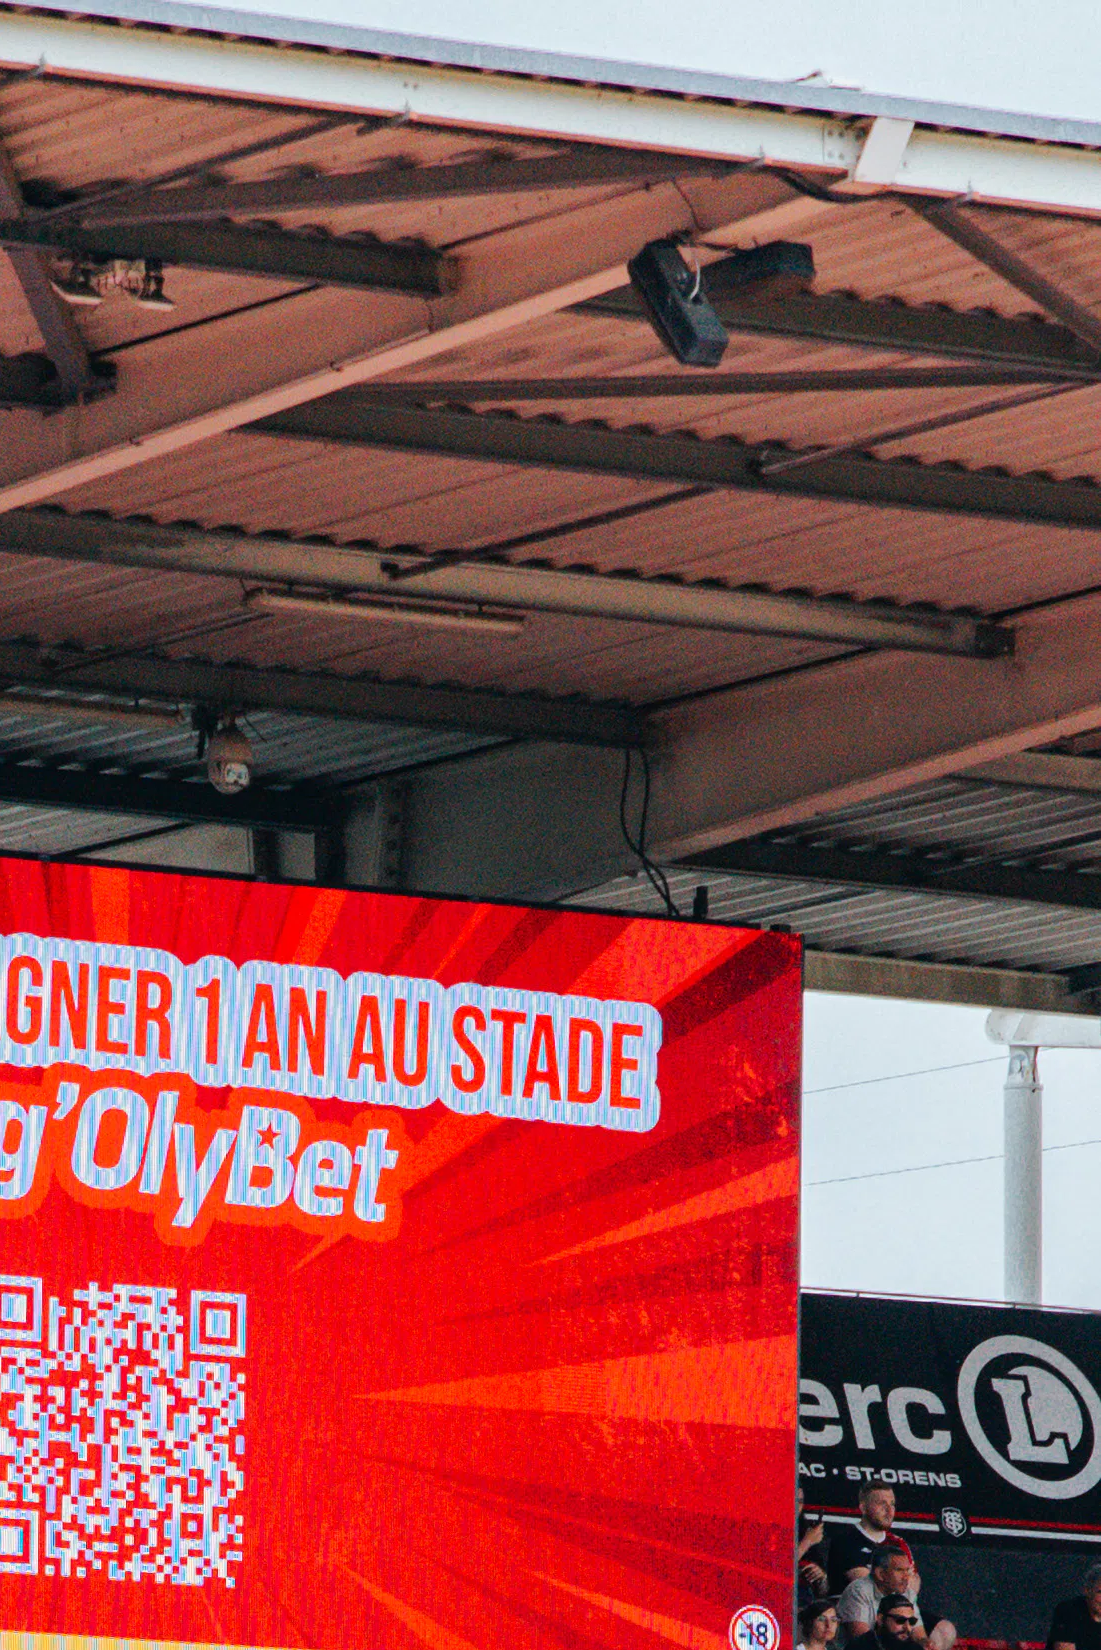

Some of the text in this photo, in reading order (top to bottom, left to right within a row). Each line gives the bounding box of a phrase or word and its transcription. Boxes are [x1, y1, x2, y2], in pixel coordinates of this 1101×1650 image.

[195, 978, 222, 1066] 1
[241, 983, 327, 1076] AN
[348, 995, 430, 1087] AU
[451, 1005, 644, 1110] STADE
[845, 1465, 962, 1488] ST-ORENS
